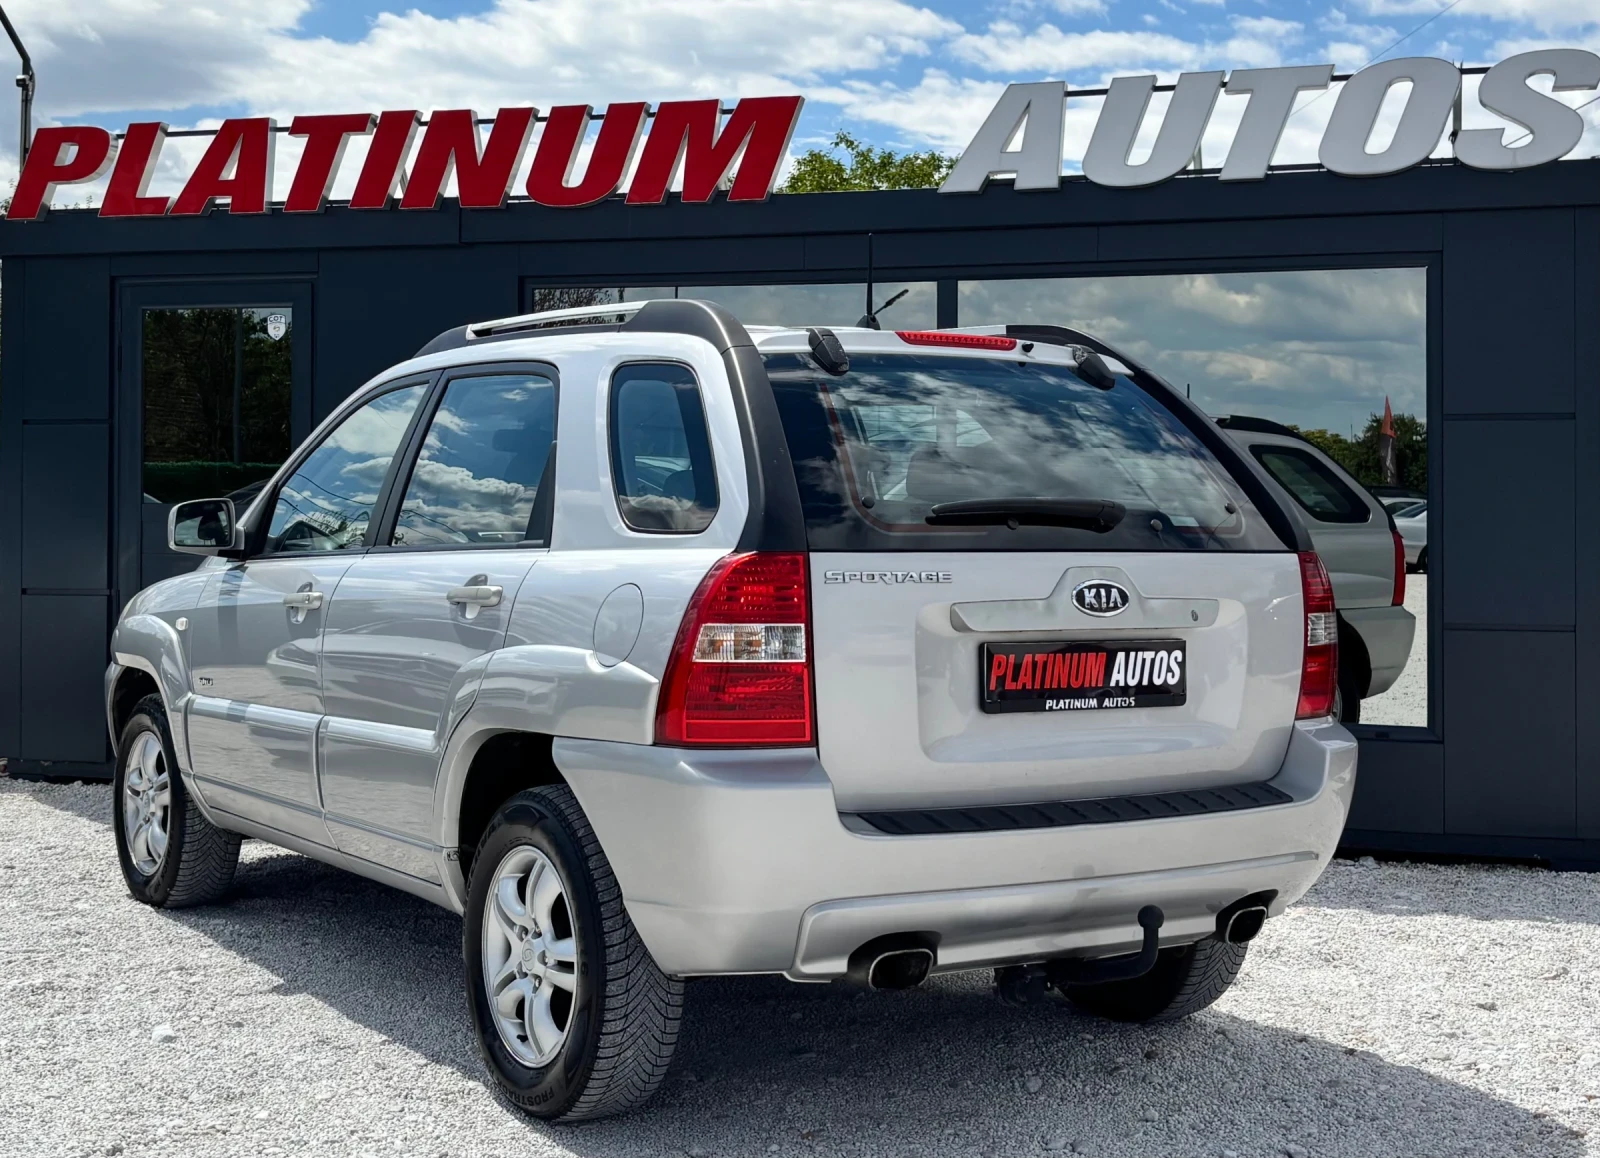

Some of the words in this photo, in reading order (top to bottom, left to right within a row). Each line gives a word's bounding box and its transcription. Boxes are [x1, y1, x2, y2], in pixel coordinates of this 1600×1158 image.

[5, 95, 804, 222] PLATINUM
[937, 48, 1600, 194] AUTOS
[824, 570, 953, 585] SPORTAGE
[1082, 588, 1123, 608] KIA
[989, 652, 1107, 690] PLATINUM
[1109, 650, 1183, 687] AUTOS
[1045, 698, 1098, 710] PLATINUM
[1102, 697, 1136, 708] AUTOS
